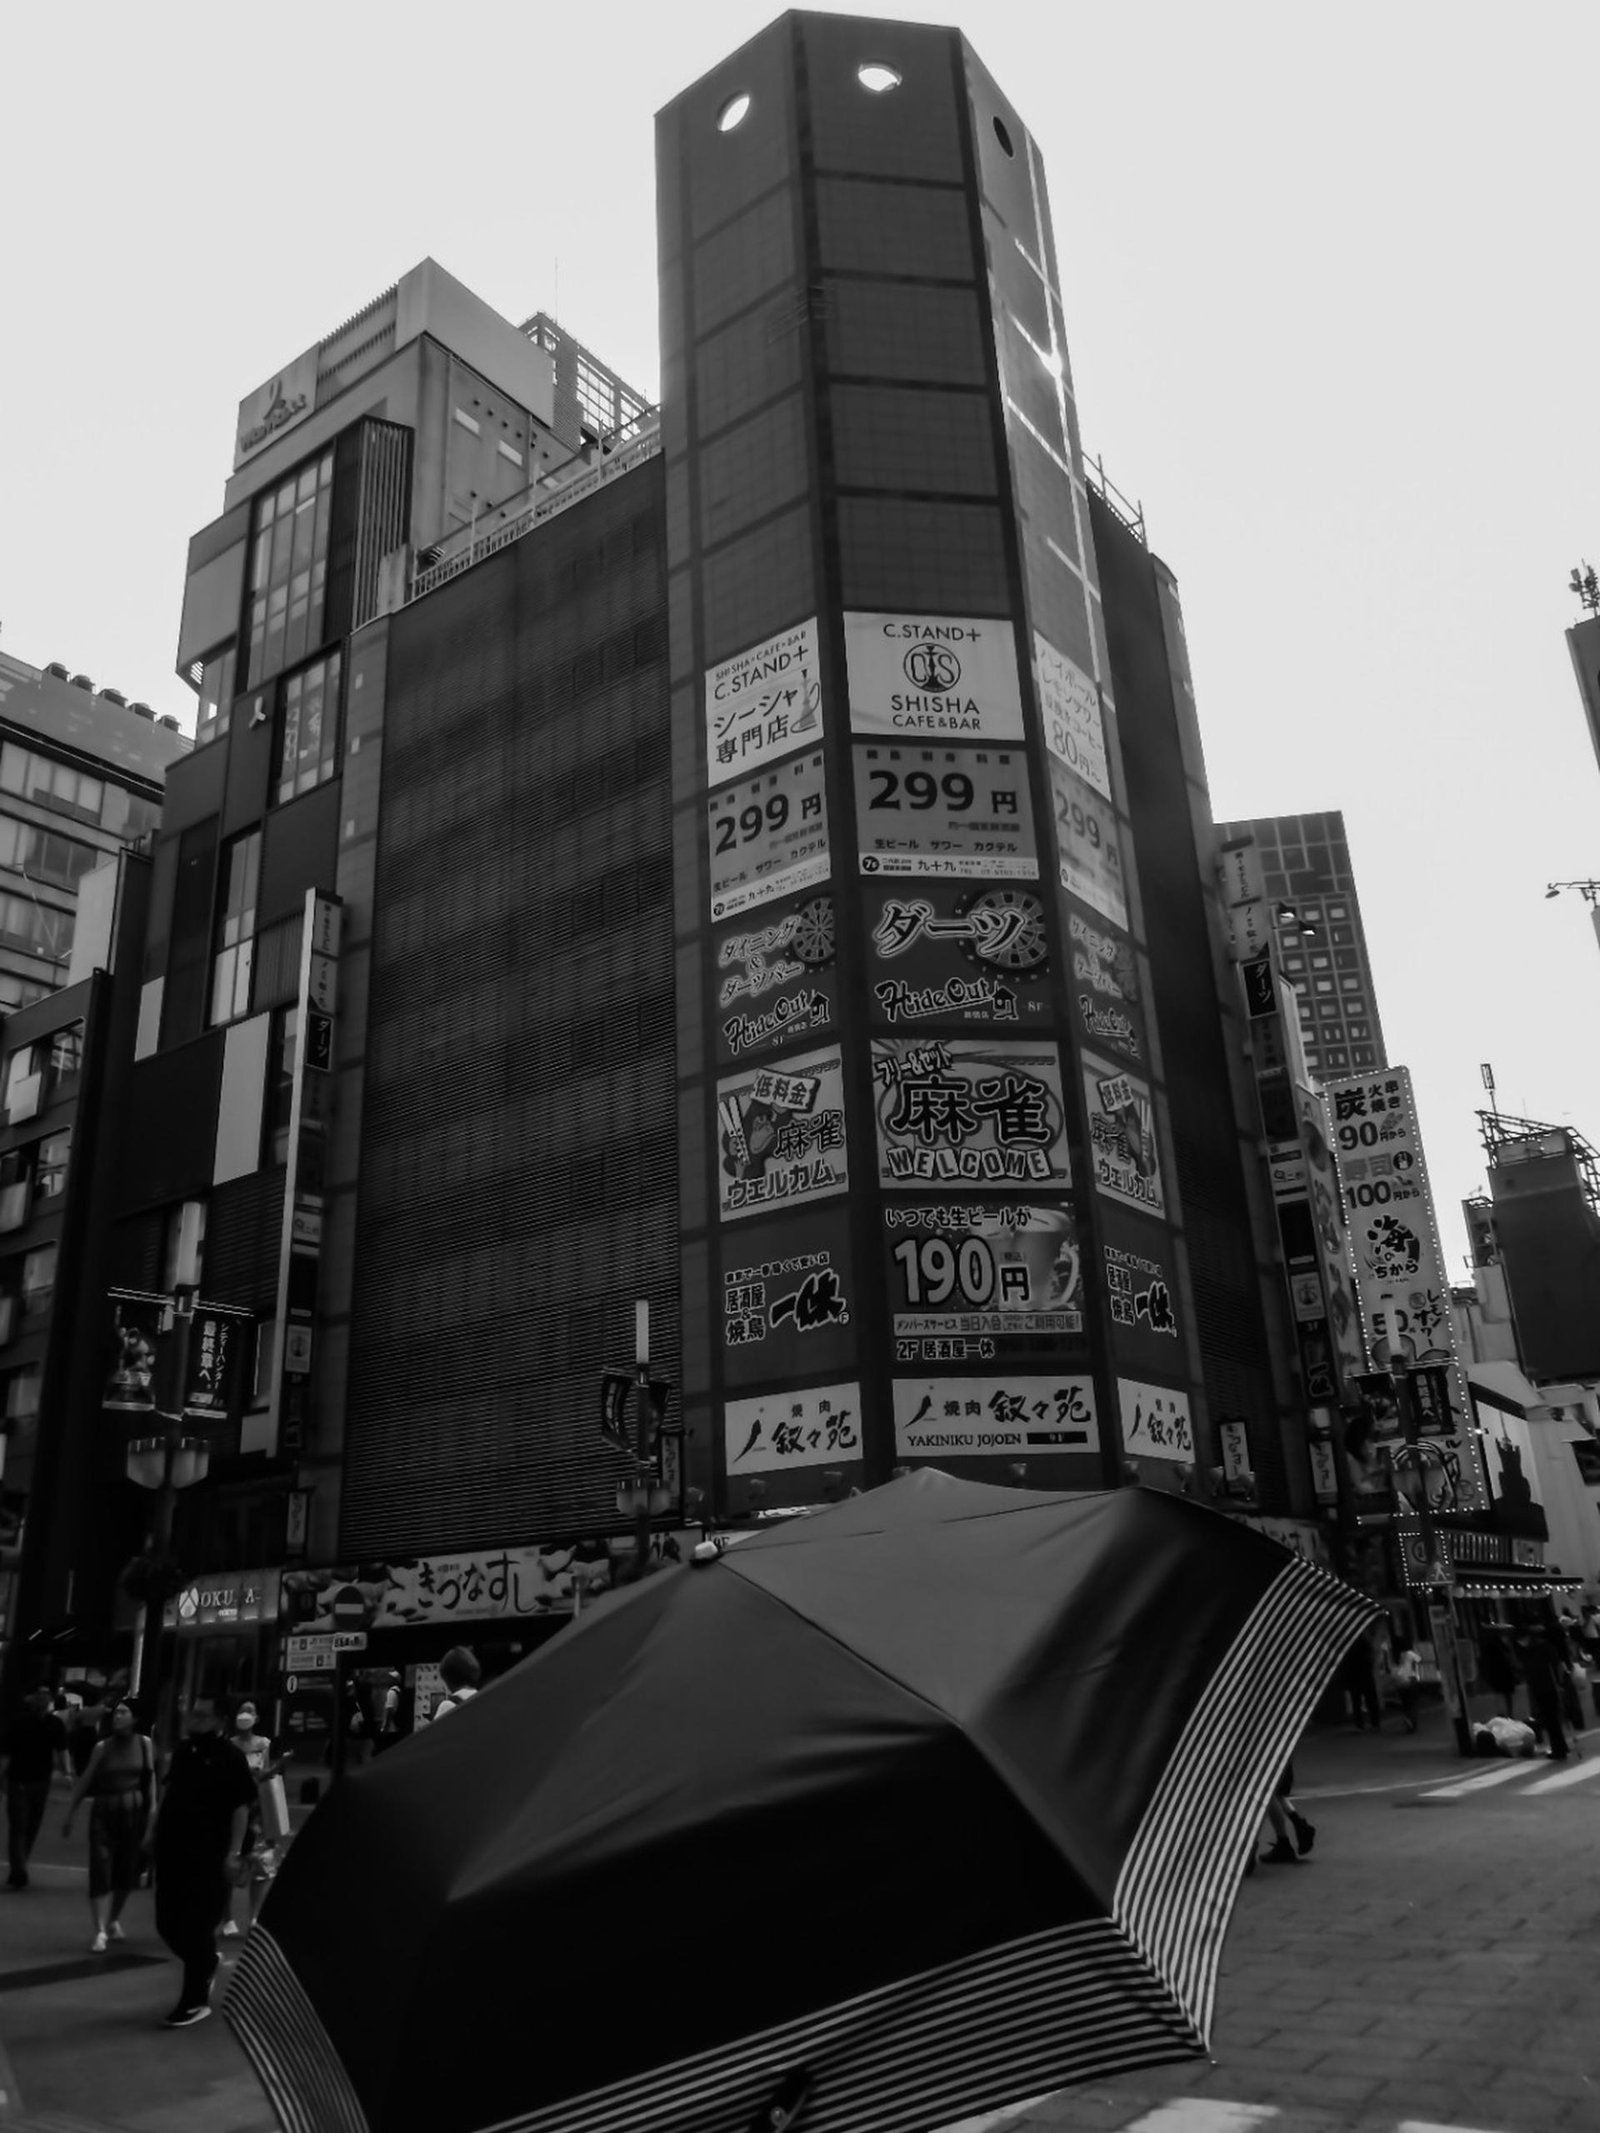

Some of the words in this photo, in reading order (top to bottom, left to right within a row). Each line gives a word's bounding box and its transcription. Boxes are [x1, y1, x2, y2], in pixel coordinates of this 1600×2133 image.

[883, 623, 982, 642] C.STAND+
[714, 645, 808, 699] C.STAND+
[714, 690, 798, 739] シーシャ
[891, 694, 980, 715] SHISHA
[716, 714, 789, 763] 専門店
[869, 769, 974, 811] 299
[991, 791, 1018, 814] 円
[715, 793, 789, 857] 299
[801, 793, 822, 820] 円
[1055, 789, 1100, 850] 299
[875, 839, 919, 850] 生ビール
[930, 841, 962, 851] サワー
[974, 842, 1018, 853] カクテル
[917, 860, 957, 874] 九十九
[719, 915, 803, 967] ダイニング
[873, 900, 1025, 958] ダーツ
[1256, 961, 1272, 1004] ダーツ
[754, 1073, 808, 1107] 低料金
[888, 1075, 1052, 1146] 麻雀
[772, 1110, 845, 1162] 麻雀
[1338, 1121, 1379, 1151] 90
[888, 1147, 1052, 1180] WELCOME
[1345, 1181, 1391, 1209] 100
[886, 1206, 1034, 1230] いつでも生ビールが
[893, 1236, 996, 1306] 190
[1000, 1265, 1031, 1304] 円
[1374, 1262, 1419, 1280] ちから
[724, 1282, 766, 1314] 居酒屋
[769, 1268, 847, 1333] 一休
[1134, 1281, 1174, 1333] 一休
[1426, 1288, 1443, 1329] レモン
[726, 1315, 766, 1345] 焼鳥
[960, 1315, 1002, 1331] 当日入会
[1412, 1309, 1434, 1348] サワー
[897, 1340, 919, 1360] 2F
[922, 1338, 995, 1360] 居酒屋一休
[943, 1400, 981, 1417] 焼肉
[988, 1386, 1091, 1424] 叙々苑
[771, 1410, 857, 1455] 叙々苑
[907, 1434, 973, 1448] YAKINIKU
[977, 1433, 1022, 1448] JOJOEN
[1147, 1412, 1192, 1451] 叙々苑
[417, 1551, 538, 1615] きづなすし
